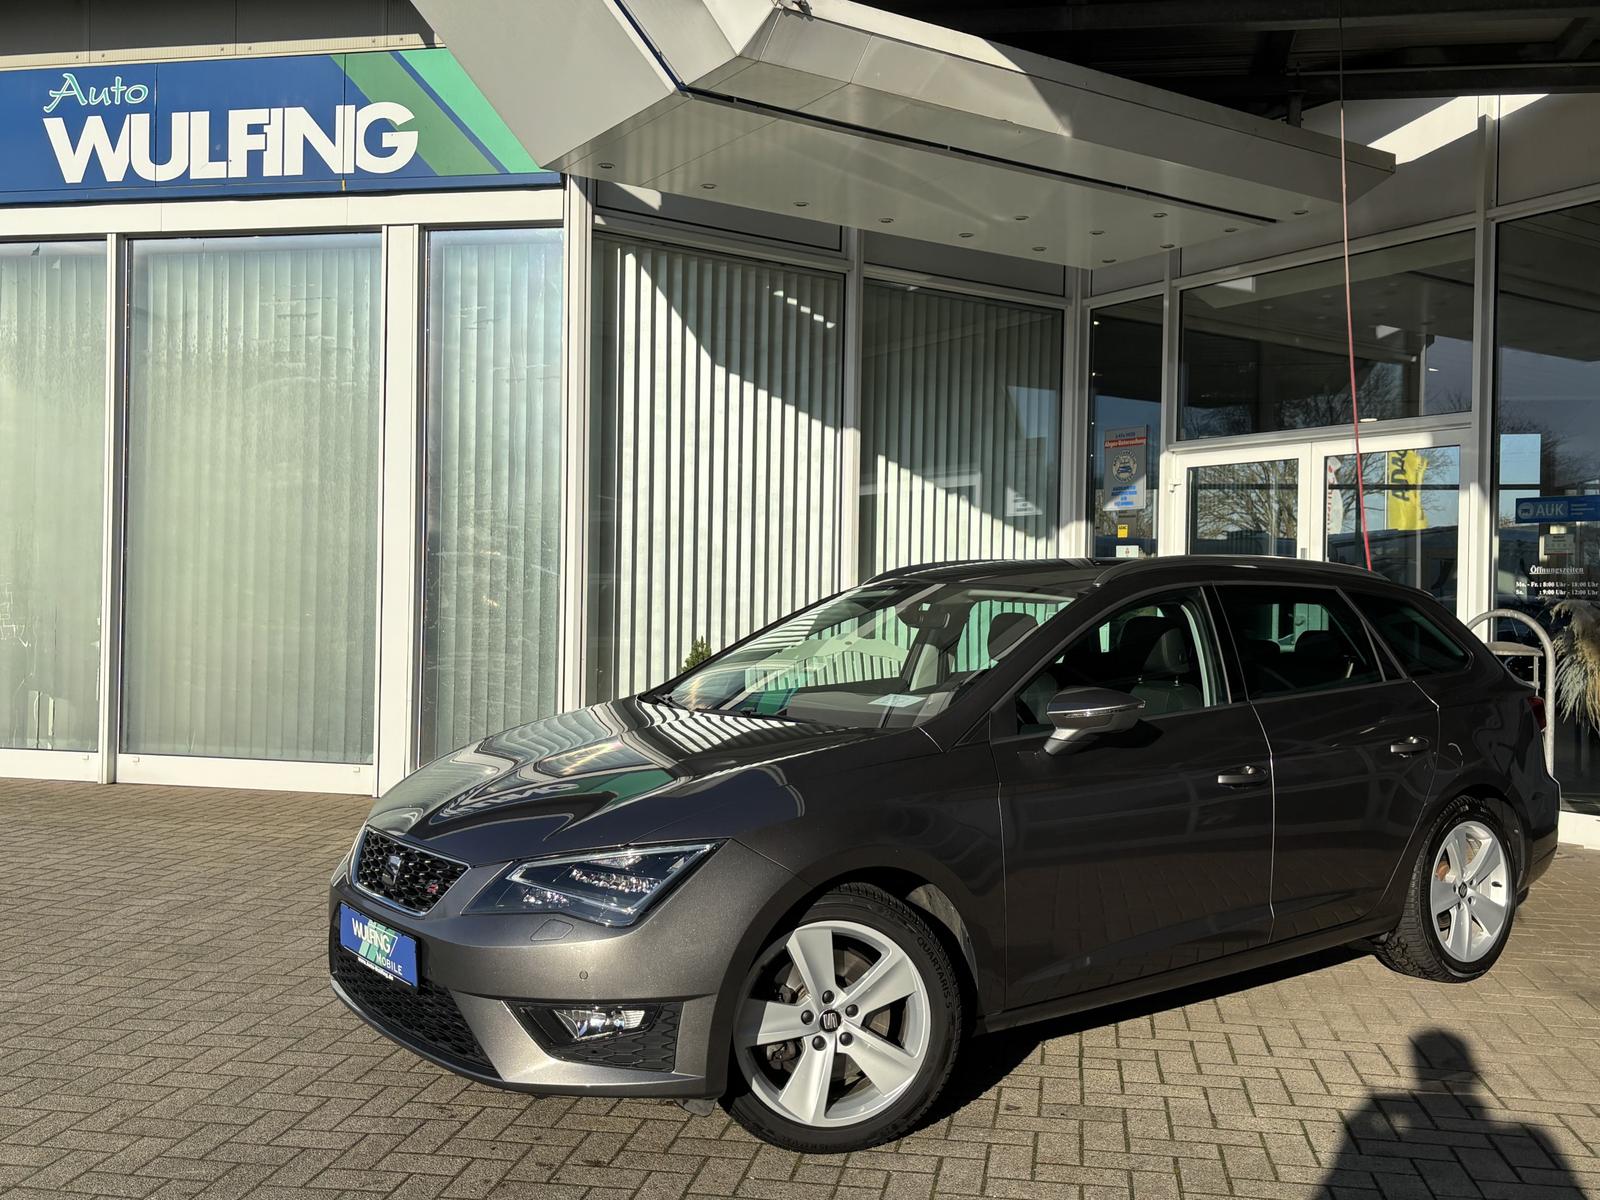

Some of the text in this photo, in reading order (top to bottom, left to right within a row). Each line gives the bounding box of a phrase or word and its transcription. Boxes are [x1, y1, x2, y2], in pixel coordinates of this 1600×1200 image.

[43, 72, 148, 113] Auto
[42, 101, 419, 184] WULFING
[1535, 503, 1564, 517] AUK
[1530, 564, 1584, 574] Öffnungszeiten
[352, 917, 391, 953] WULFING
[376, 951, 403, 976] MOBILE
[916, 936, 951, 999] QUARTARIS
